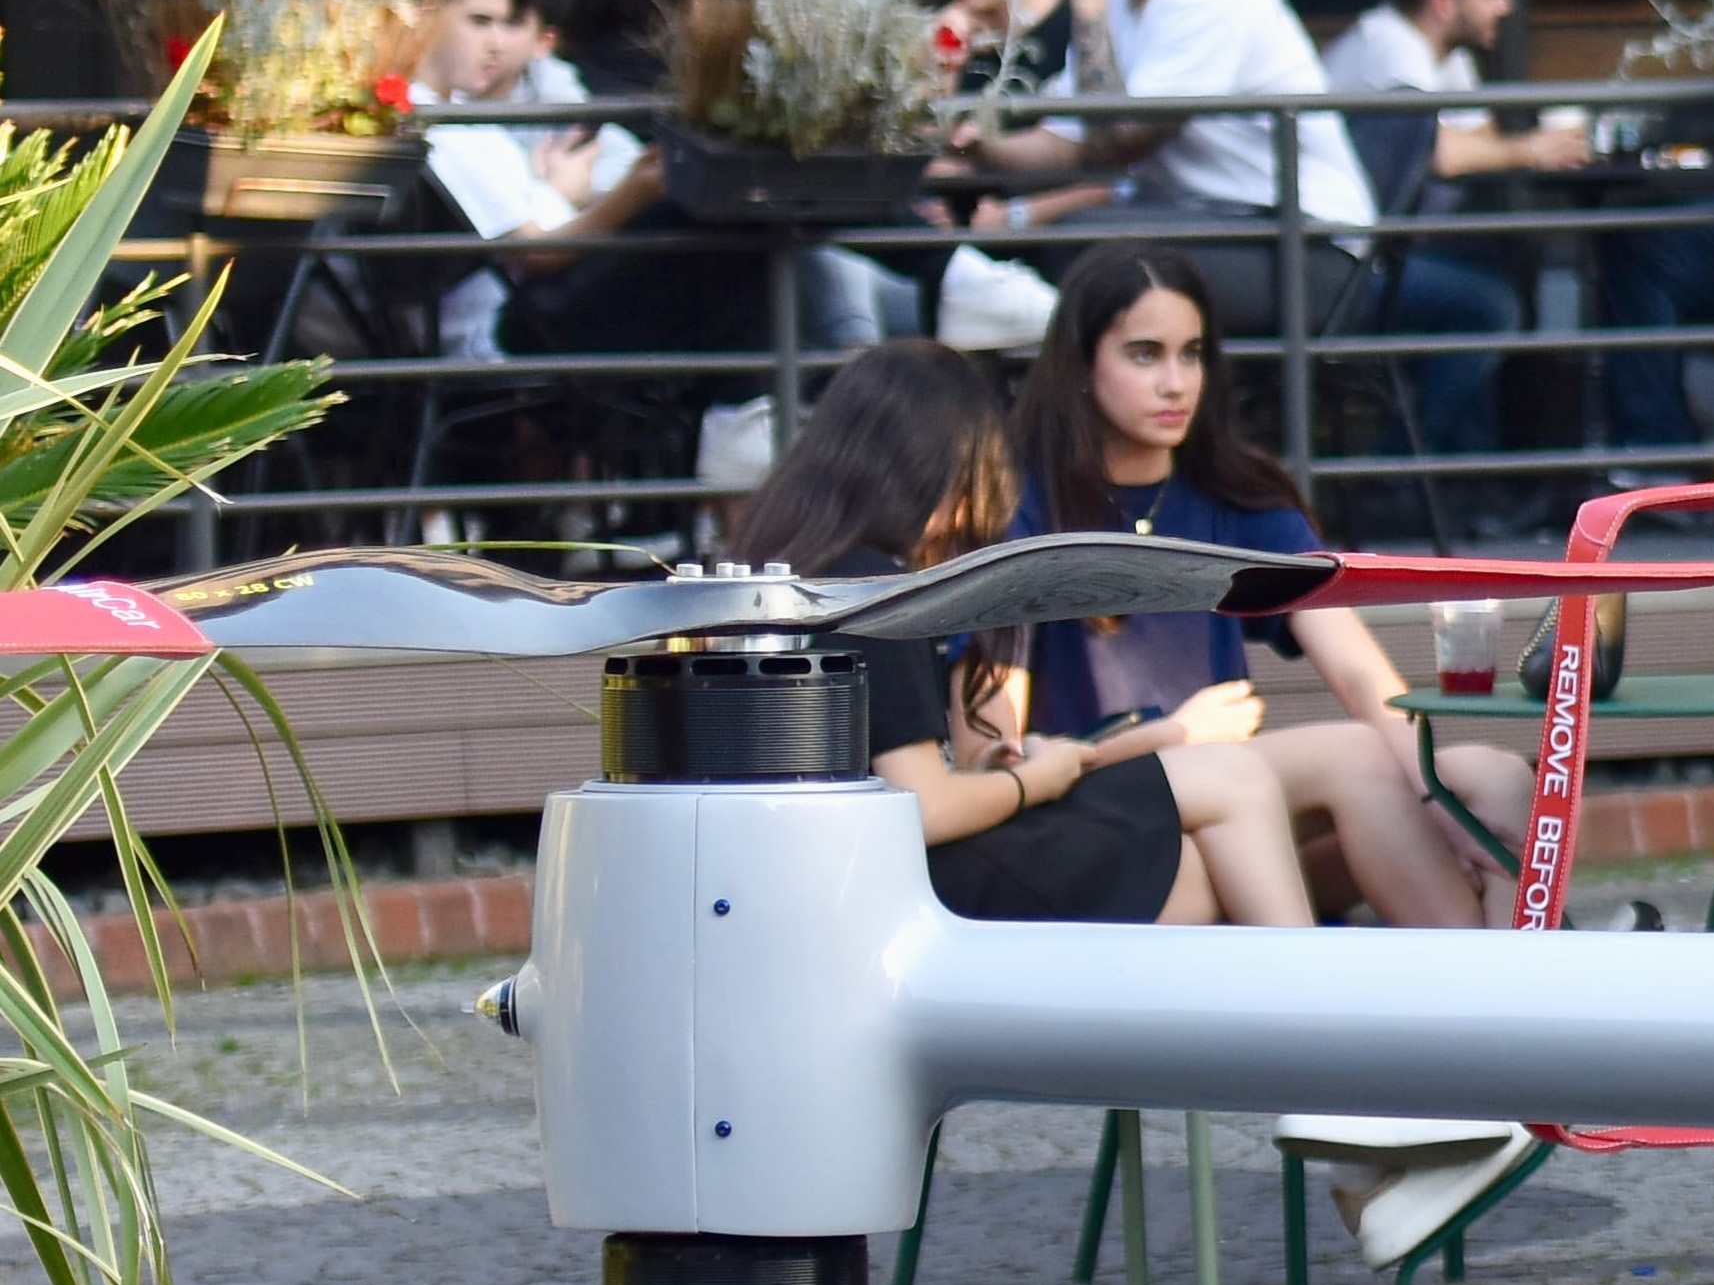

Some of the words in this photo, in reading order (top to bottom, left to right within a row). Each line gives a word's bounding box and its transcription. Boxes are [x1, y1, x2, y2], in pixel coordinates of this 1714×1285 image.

[273, 575, 315, 590] CW
[1543, 644, 1580, 798] REMOVE
[1520, 815, 1563, 931] BEFOR
